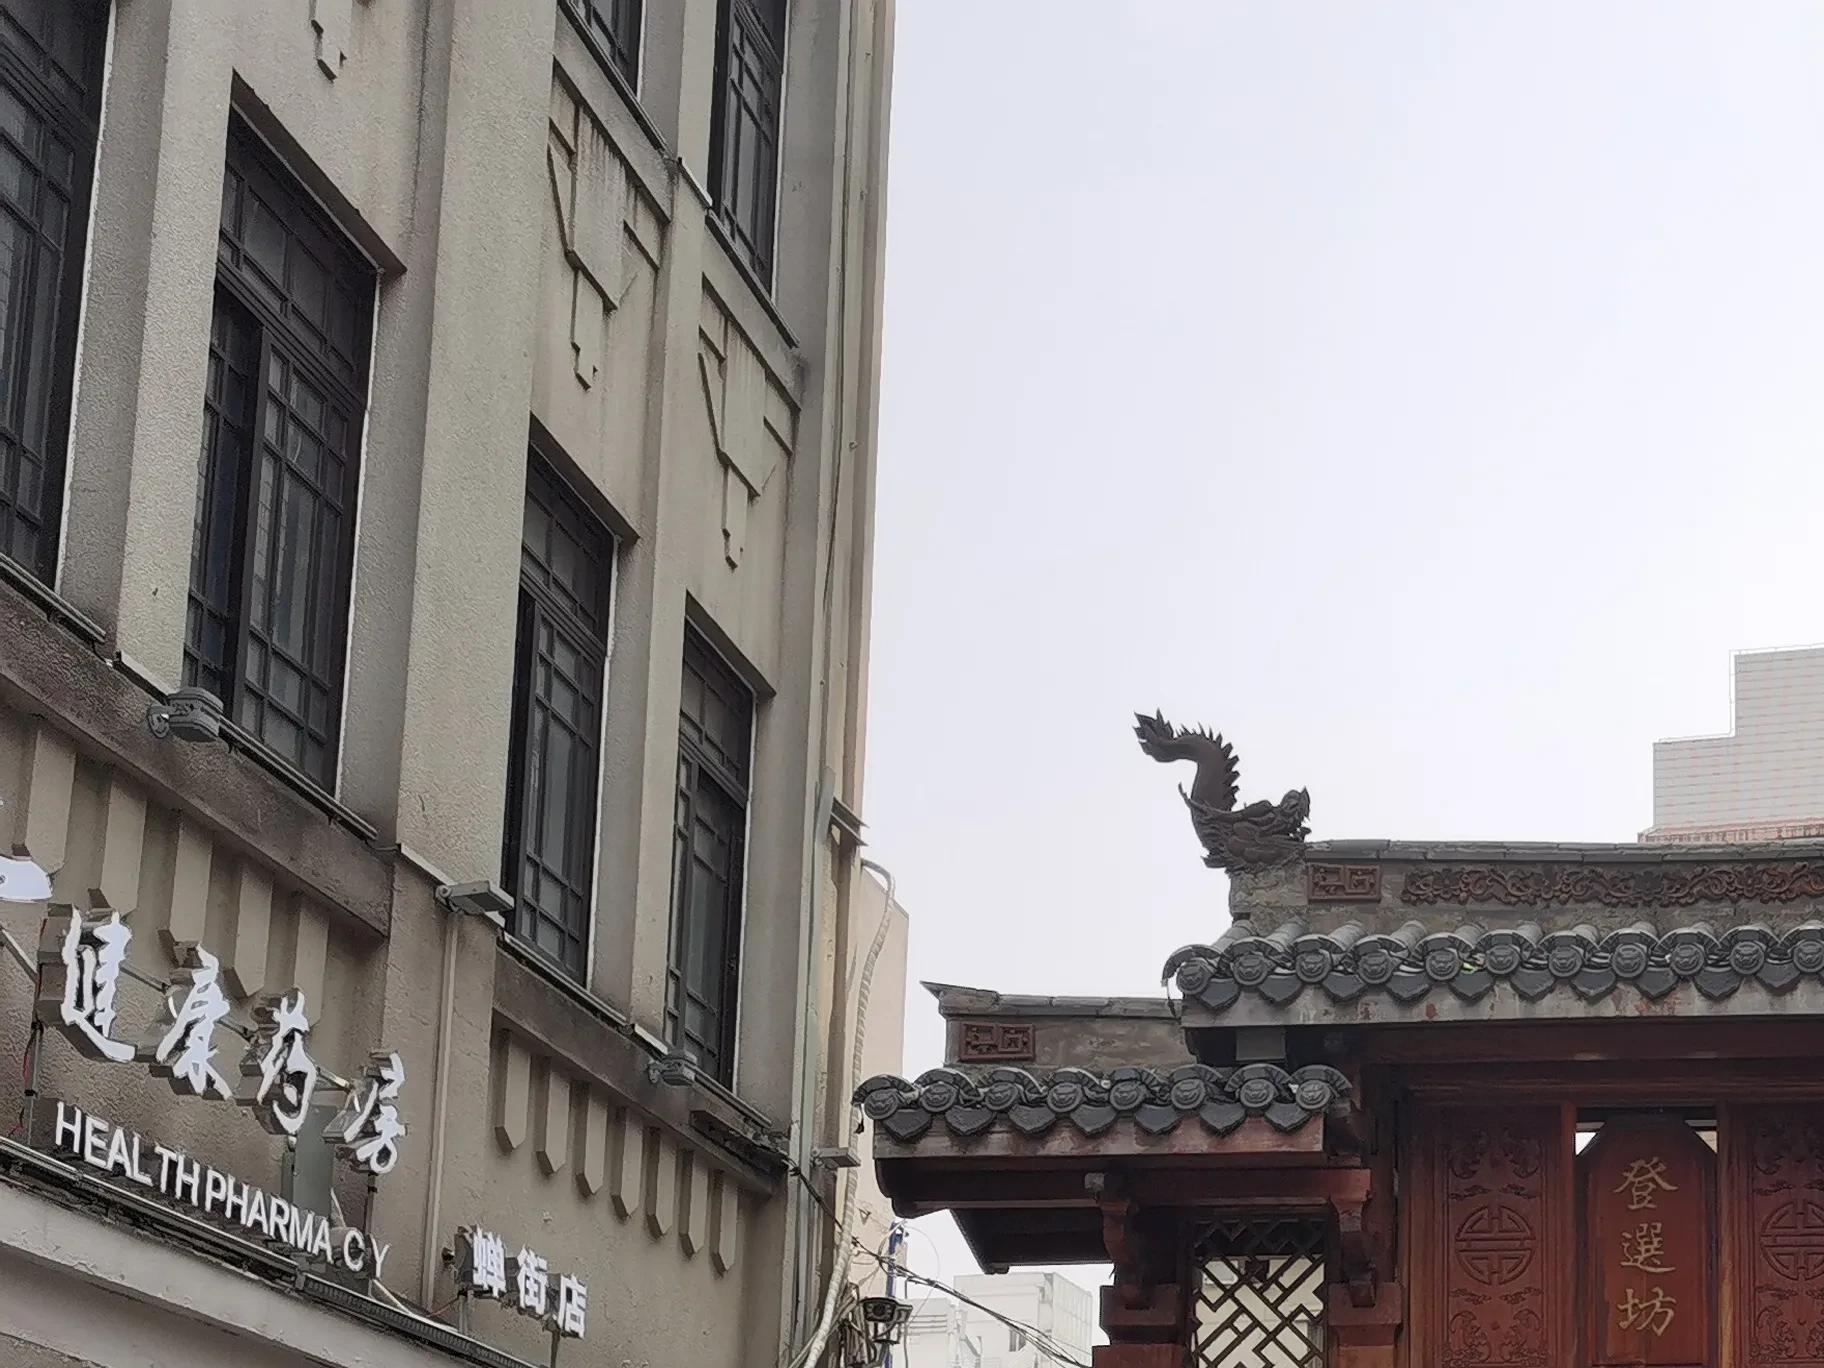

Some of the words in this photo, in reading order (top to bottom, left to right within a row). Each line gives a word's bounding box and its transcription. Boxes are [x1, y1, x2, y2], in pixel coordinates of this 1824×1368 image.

[56, 1102, 199, 1206] HEALTH
[204, 1171, 391, 1278] PHARMACY
[472, 1225, 588, 1340] 蝉街店
